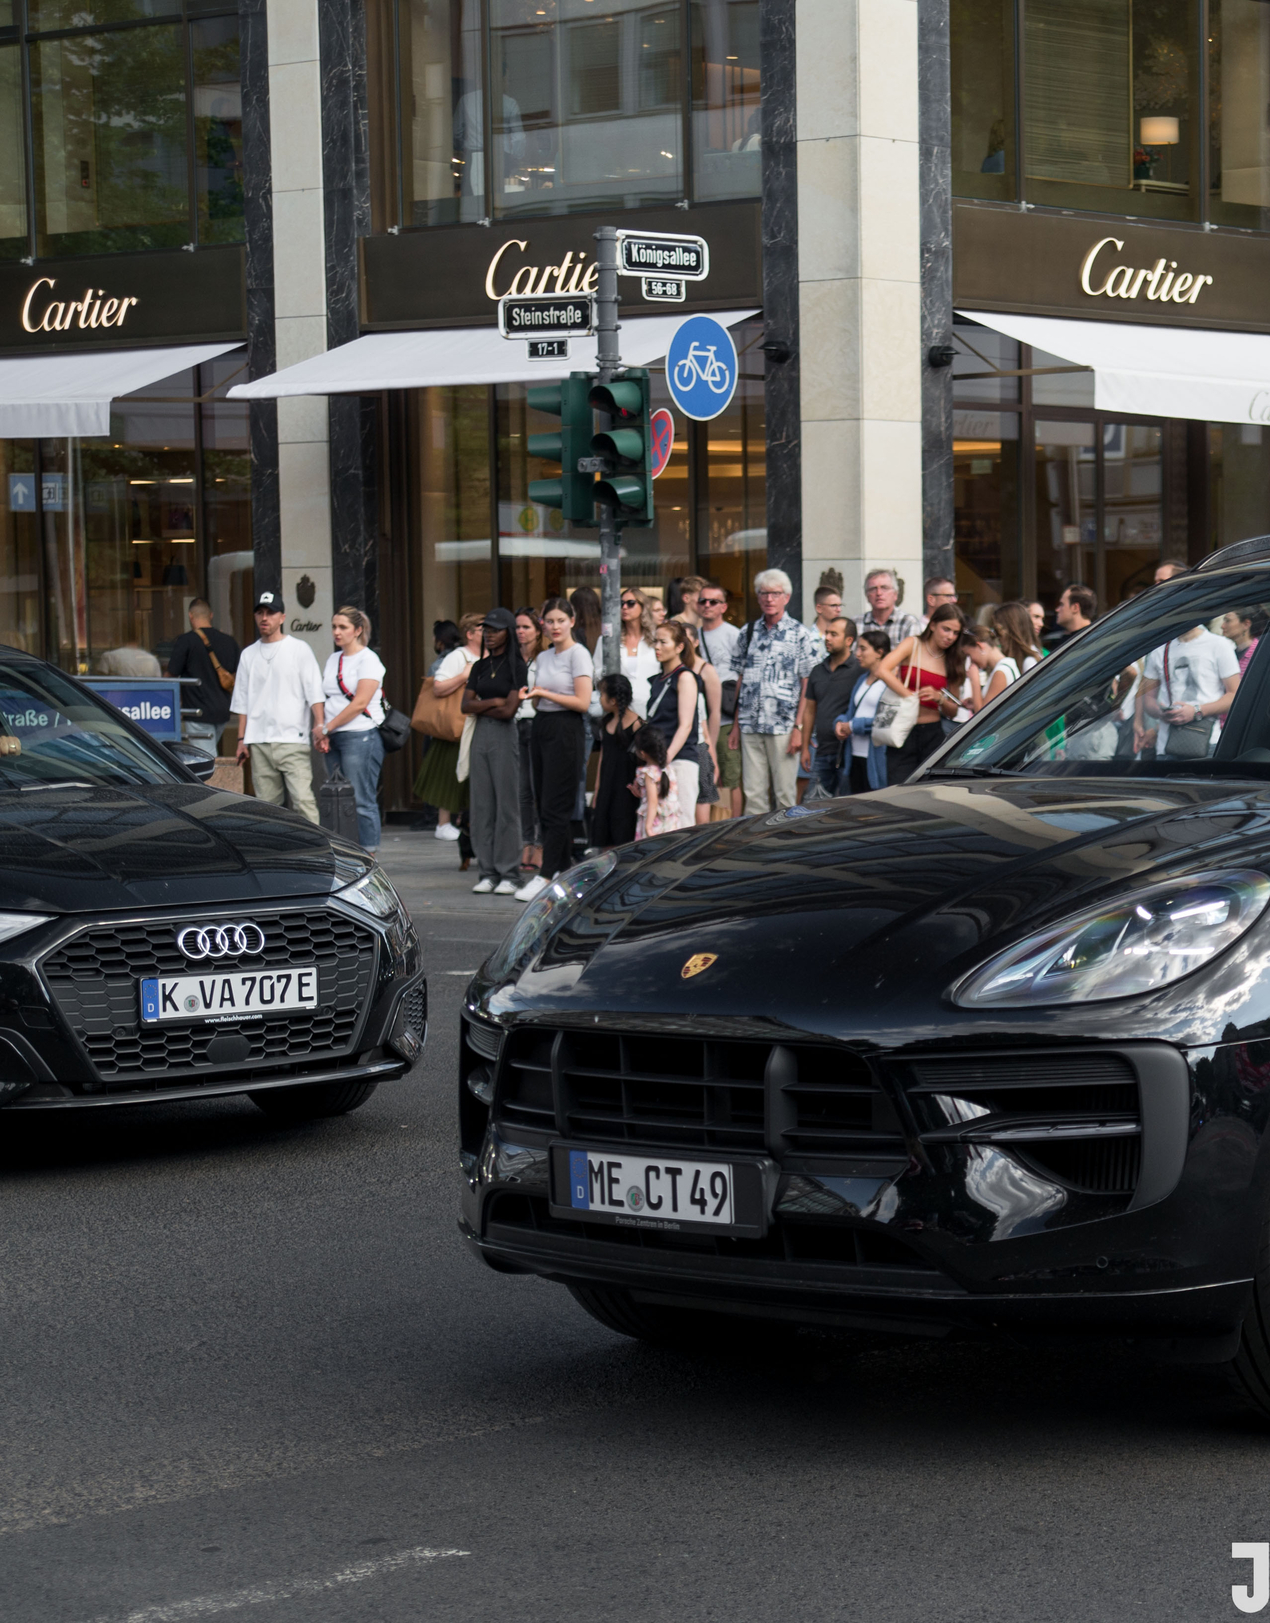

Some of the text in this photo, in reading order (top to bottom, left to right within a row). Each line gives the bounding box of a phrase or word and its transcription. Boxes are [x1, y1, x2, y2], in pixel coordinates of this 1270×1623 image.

[631, 243, 697, 267] Königsallee
[485, 239, 599, 300] Cartie
[1079, 236, 1214, 304] Cartier
[651, 281, 677, 296] 56-68
[21, 277, 140, 333] Cartier
[511, 305, 582, 327] Steinstraße
[537, 342, 559, 356] 17-1
[290, 618, 323, 632] Cartier
[117, 701, 172, 720] sallee
[162, 982, 180, 1013] K
[147, 1003, 155, 1013] D
[204, 1012, 263, 1024] www.fleischhauer.com
[576, 1185, 585, 1199] D
[588, 1158, 728, 1217] ME CT 49
[615, 1215, 680, 1230] Porsche Zentren in Berlin
